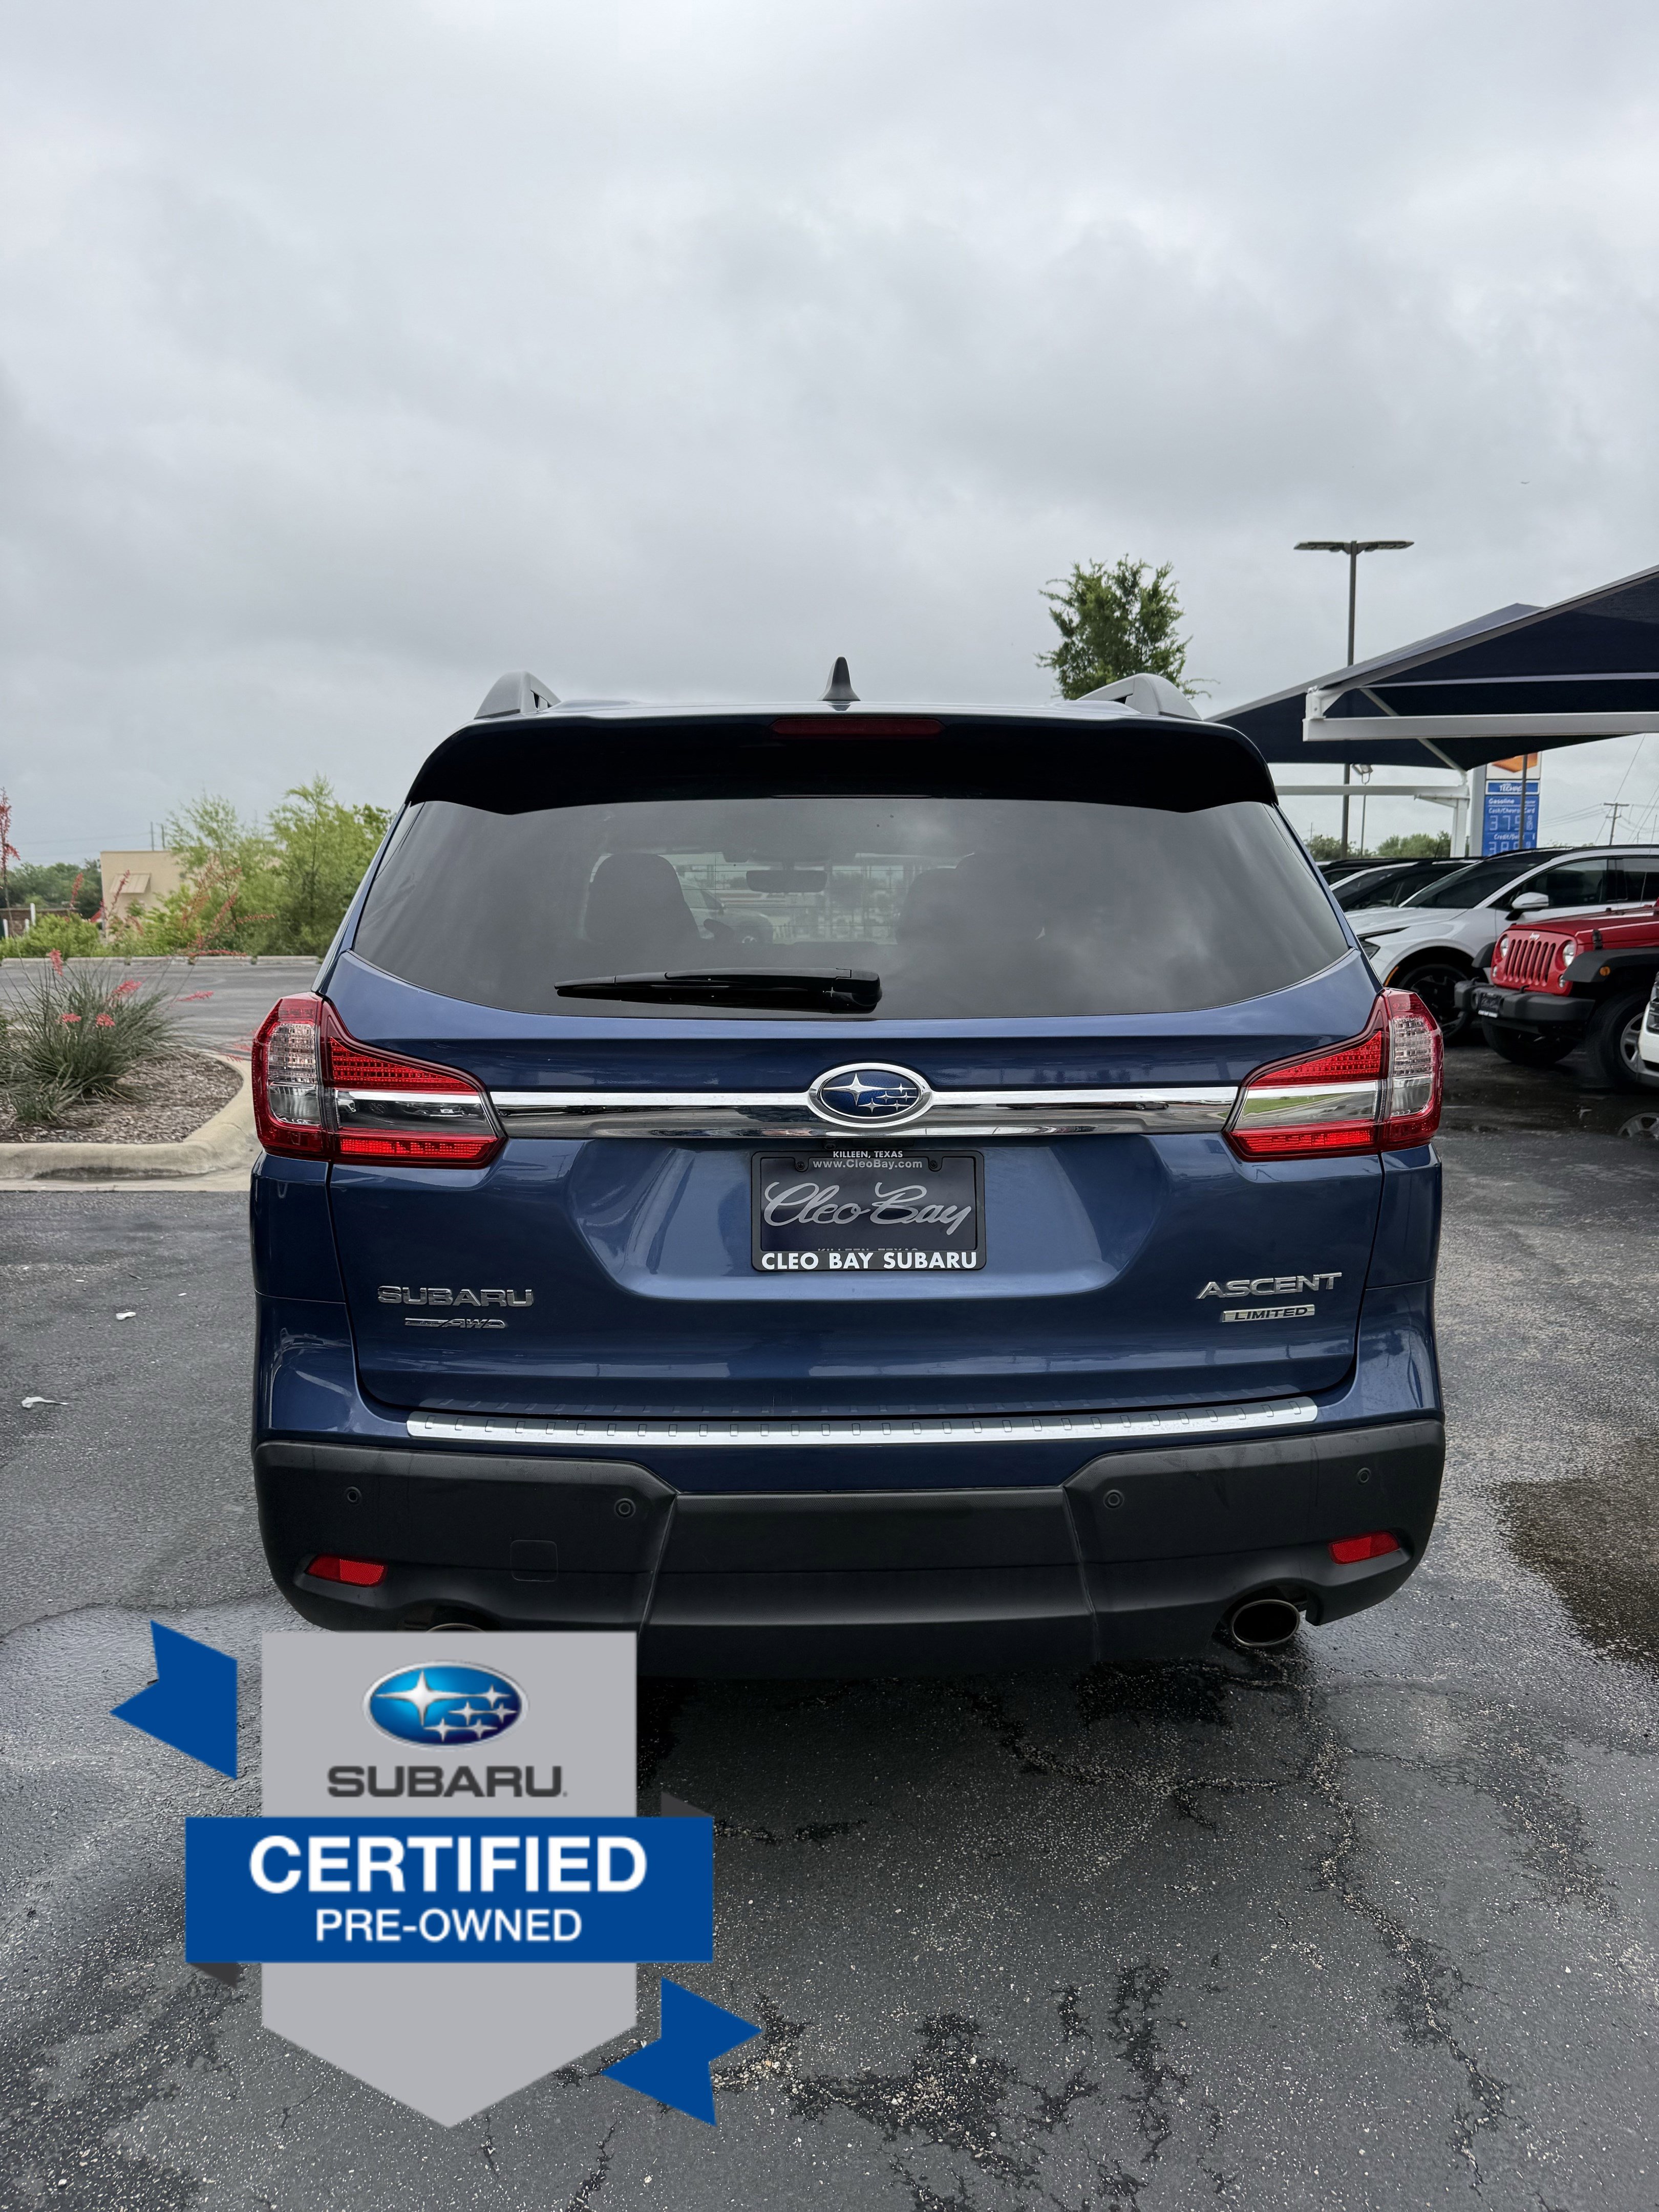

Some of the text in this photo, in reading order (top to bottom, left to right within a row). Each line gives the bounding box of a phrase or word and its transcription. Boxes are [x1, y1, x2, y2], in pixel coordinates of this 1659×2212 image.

[813, 1159, 923, 1170] www.CleoBay.com
[764, 1181, 972, 1236] Cleo Bay
[761, 1252, 977, 1270] CLEO BAY SUBARU
[1196, 1272, 1342, 1300] ASCENT
[377, 1285, 535, 1308] SUBARU
[1234, 1307, 1308, 1321] LIMITED
[442, 1318, 506, 1329] AWD
